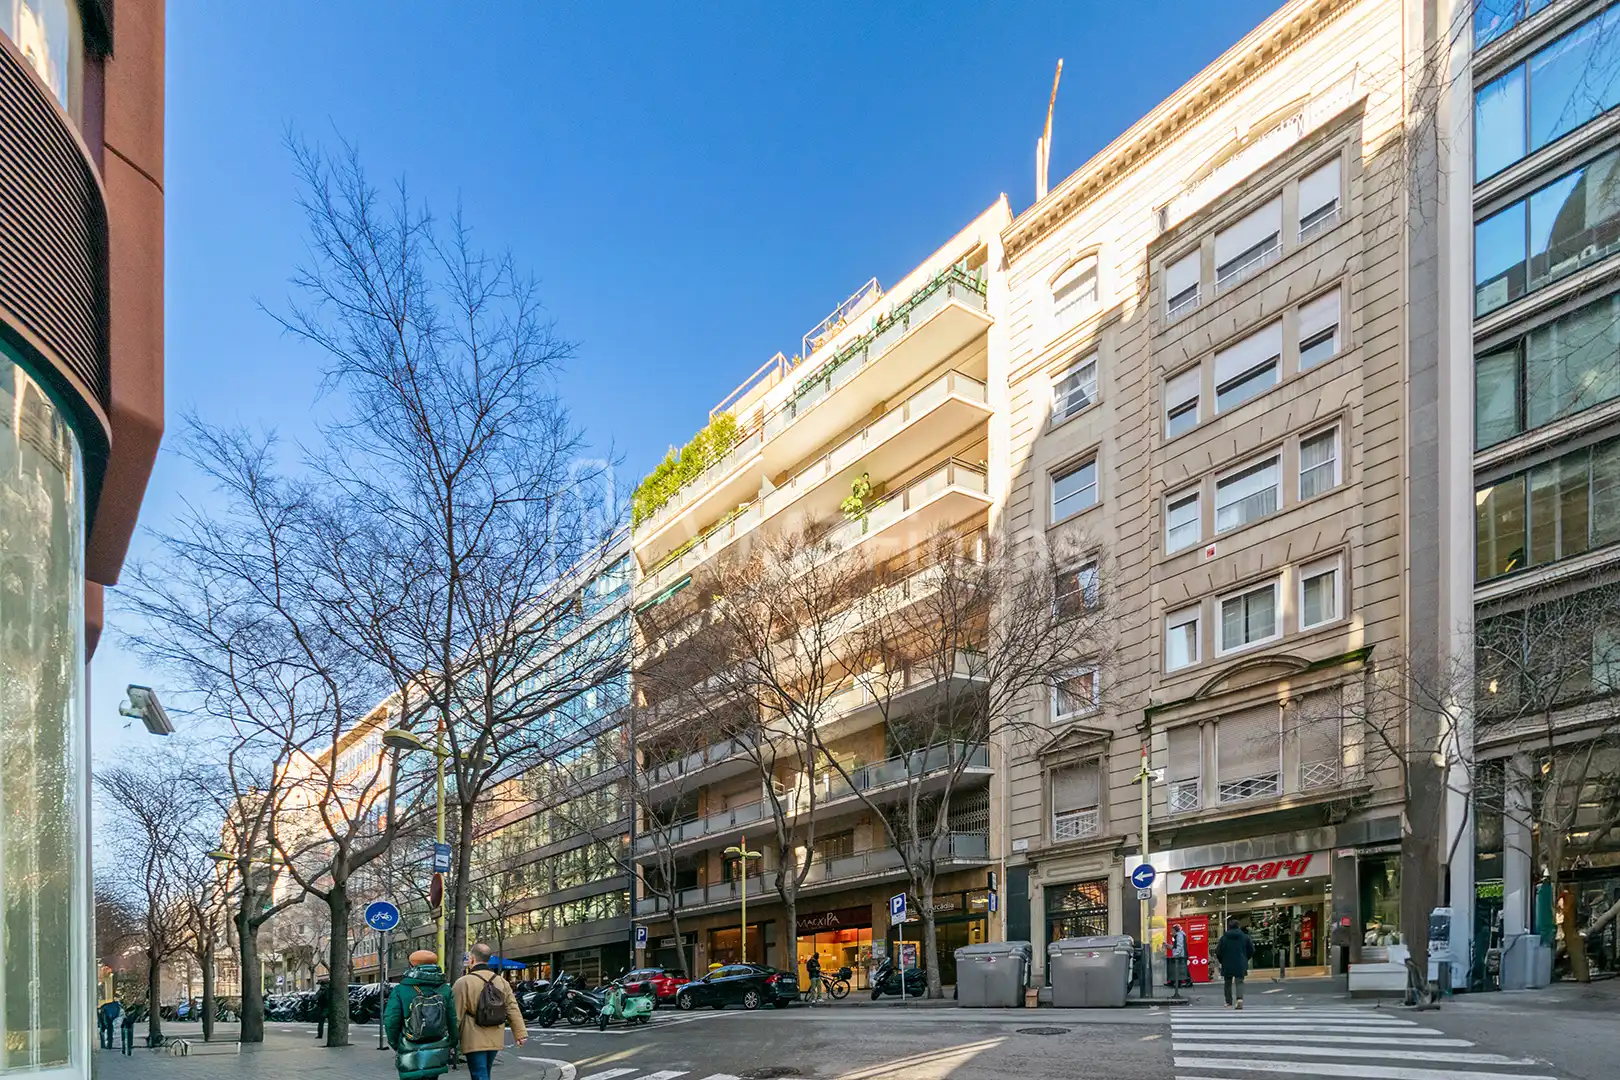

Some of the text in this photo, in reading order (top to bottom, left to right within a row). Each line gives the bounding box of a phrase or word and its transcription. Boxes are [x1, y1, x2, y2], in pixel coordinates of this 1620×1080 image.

[1180, 853, 1313, 890] Motocard
[893, 897, 903, 913] P
[637, 928, 645, 940] P
